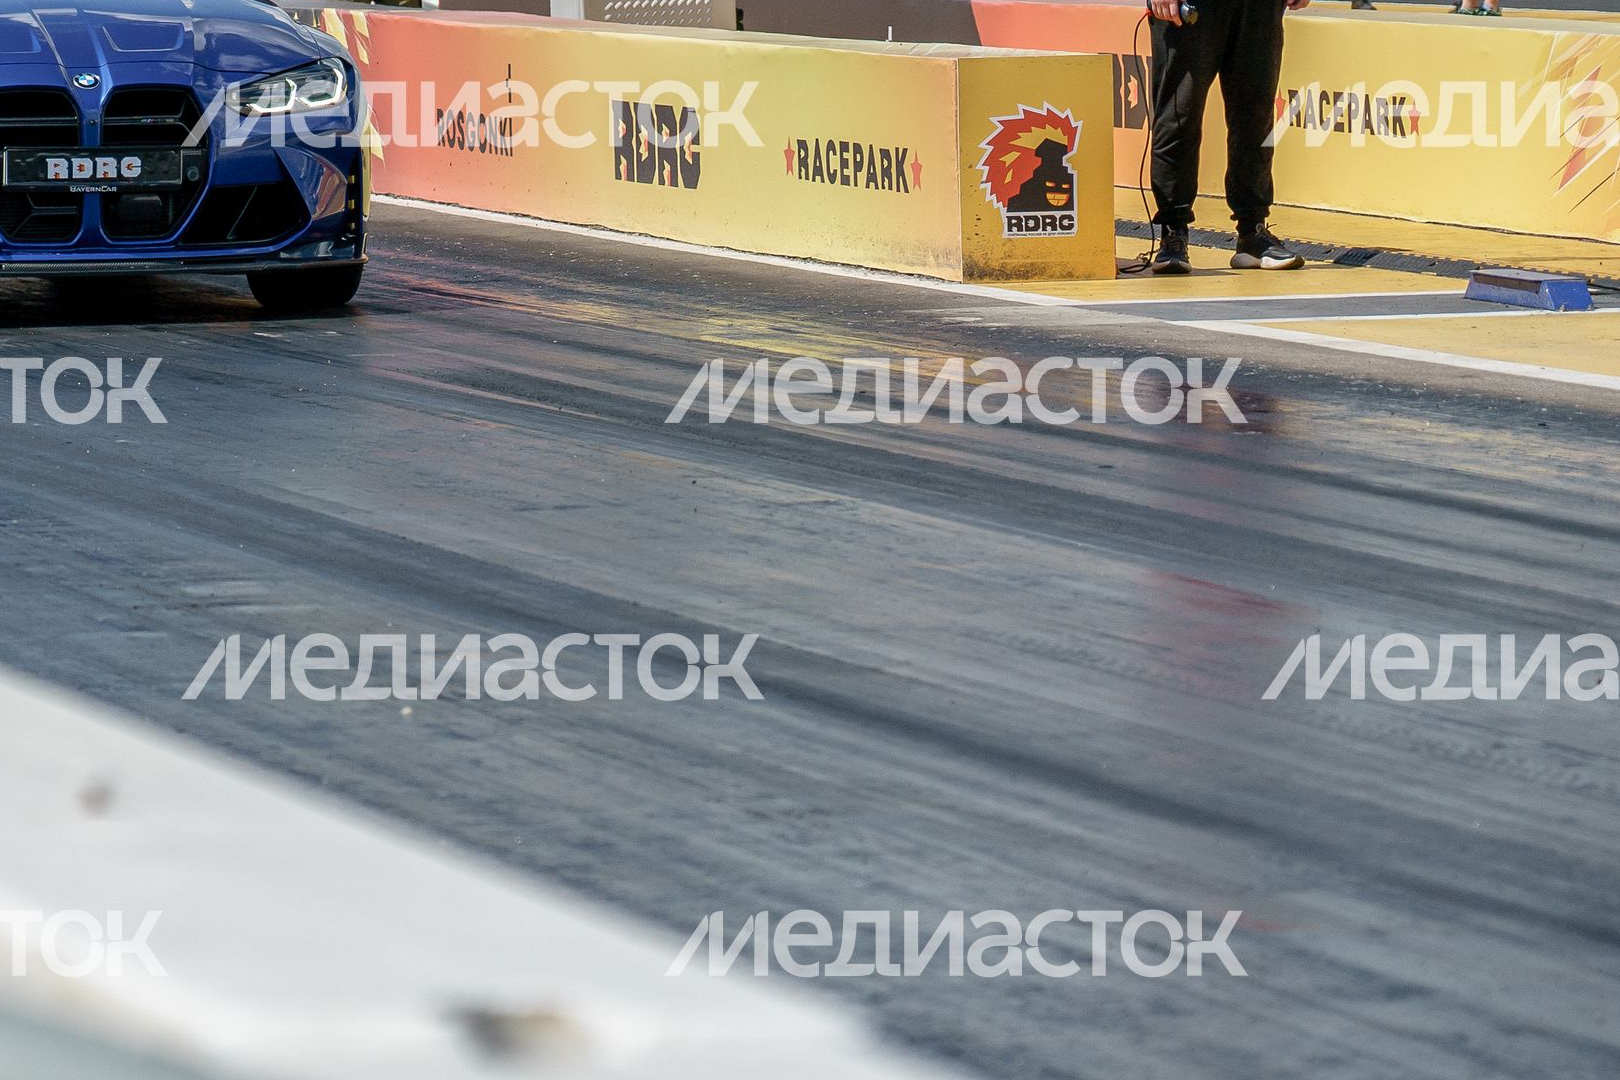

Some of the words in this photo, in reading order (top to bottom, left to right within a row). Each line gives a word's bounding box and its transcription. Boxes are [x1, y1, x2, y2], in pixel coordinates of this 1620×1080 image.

[437, 108, 513, 157] ROSGONKI
[1288, 88, 1407, 139] RACEPARK
[46, 156, 142, 180] RDRC
[797, 138, 910, 194] RACEPARK
[1006, 214, 1075, 232] RDRC
